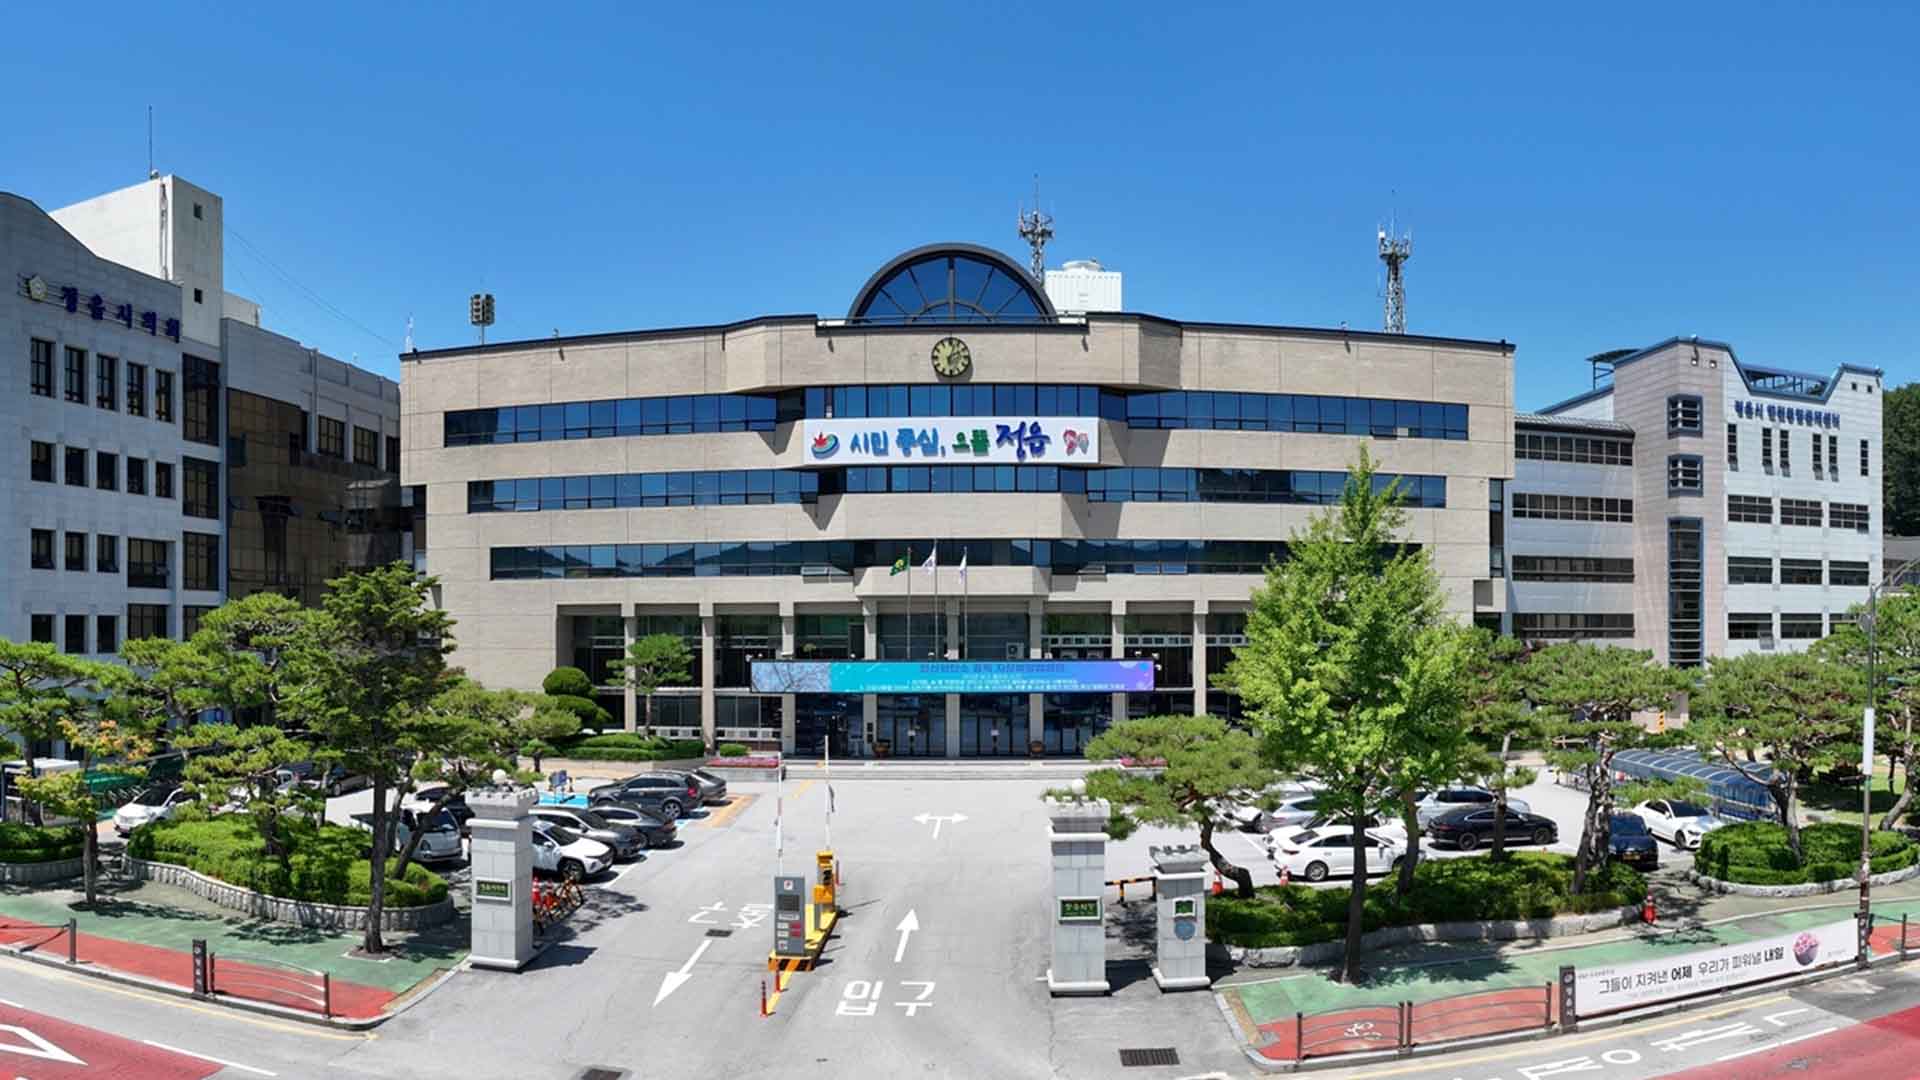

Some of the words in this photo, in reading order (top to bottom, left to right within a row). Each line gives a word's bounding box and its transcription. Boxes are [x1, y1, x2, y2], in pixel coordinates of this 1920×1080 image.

[850, 431, 889, 456] 시민
[896, 428, 946, 457] 중심,
[952, 429, 990, 456] 으뜸
[996, 421, 1051, 462] 정읍
[1599, 975, 1633, 994] 그들이
[1635, 970, 1668, 987] 지켜낸
[1671, 965, 1693, 981] 어제
[1698, 958, 1729, 975] 우리가
[1732, 951, 1762, 970] 피워낼
[1764, 946, 1784, 962] 내일
[836, 980, 936, 1016] 입구
